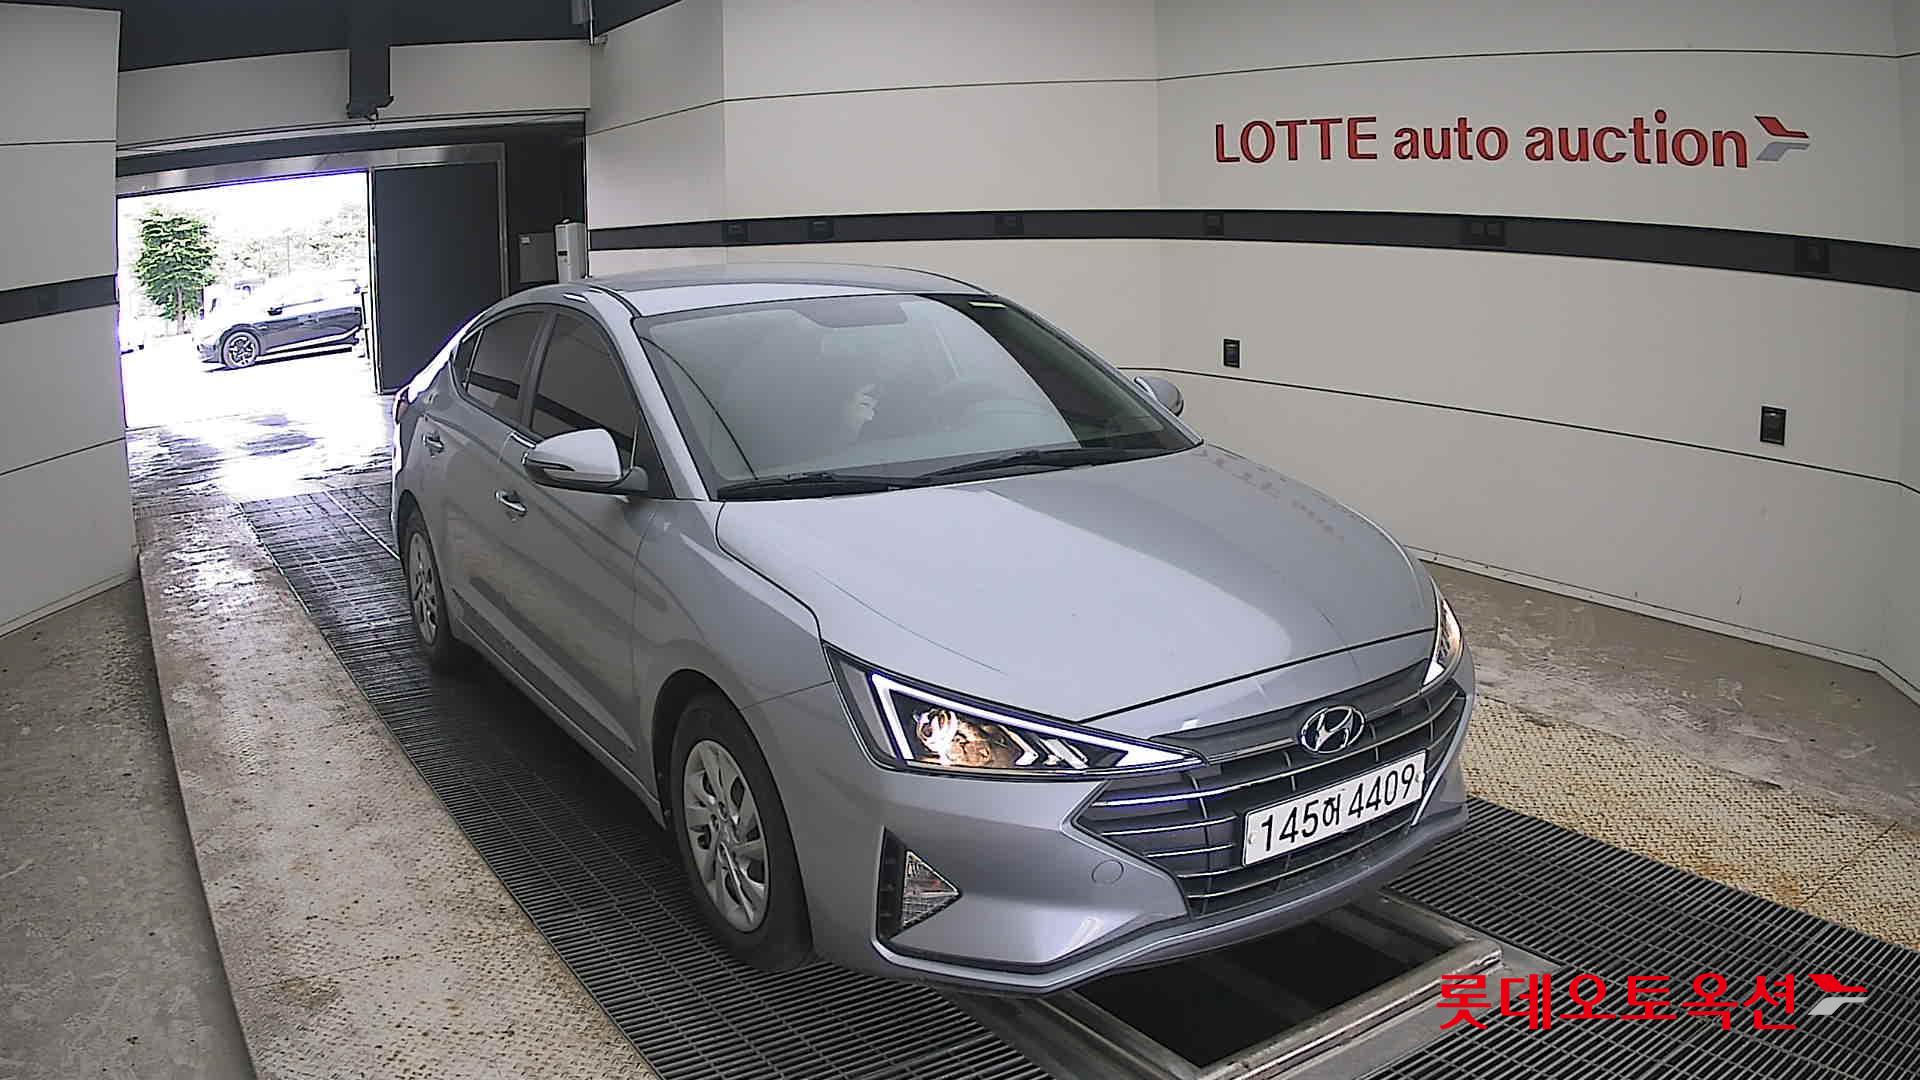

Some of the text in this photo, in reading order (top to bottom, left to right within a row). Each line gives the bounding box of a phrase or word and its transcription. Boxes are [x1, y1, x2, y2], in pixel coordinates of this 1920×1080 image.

[1215, 109, 1749, 169] LOTTE auto auction
[1260, 763, 1416, 852] 145허 4409
